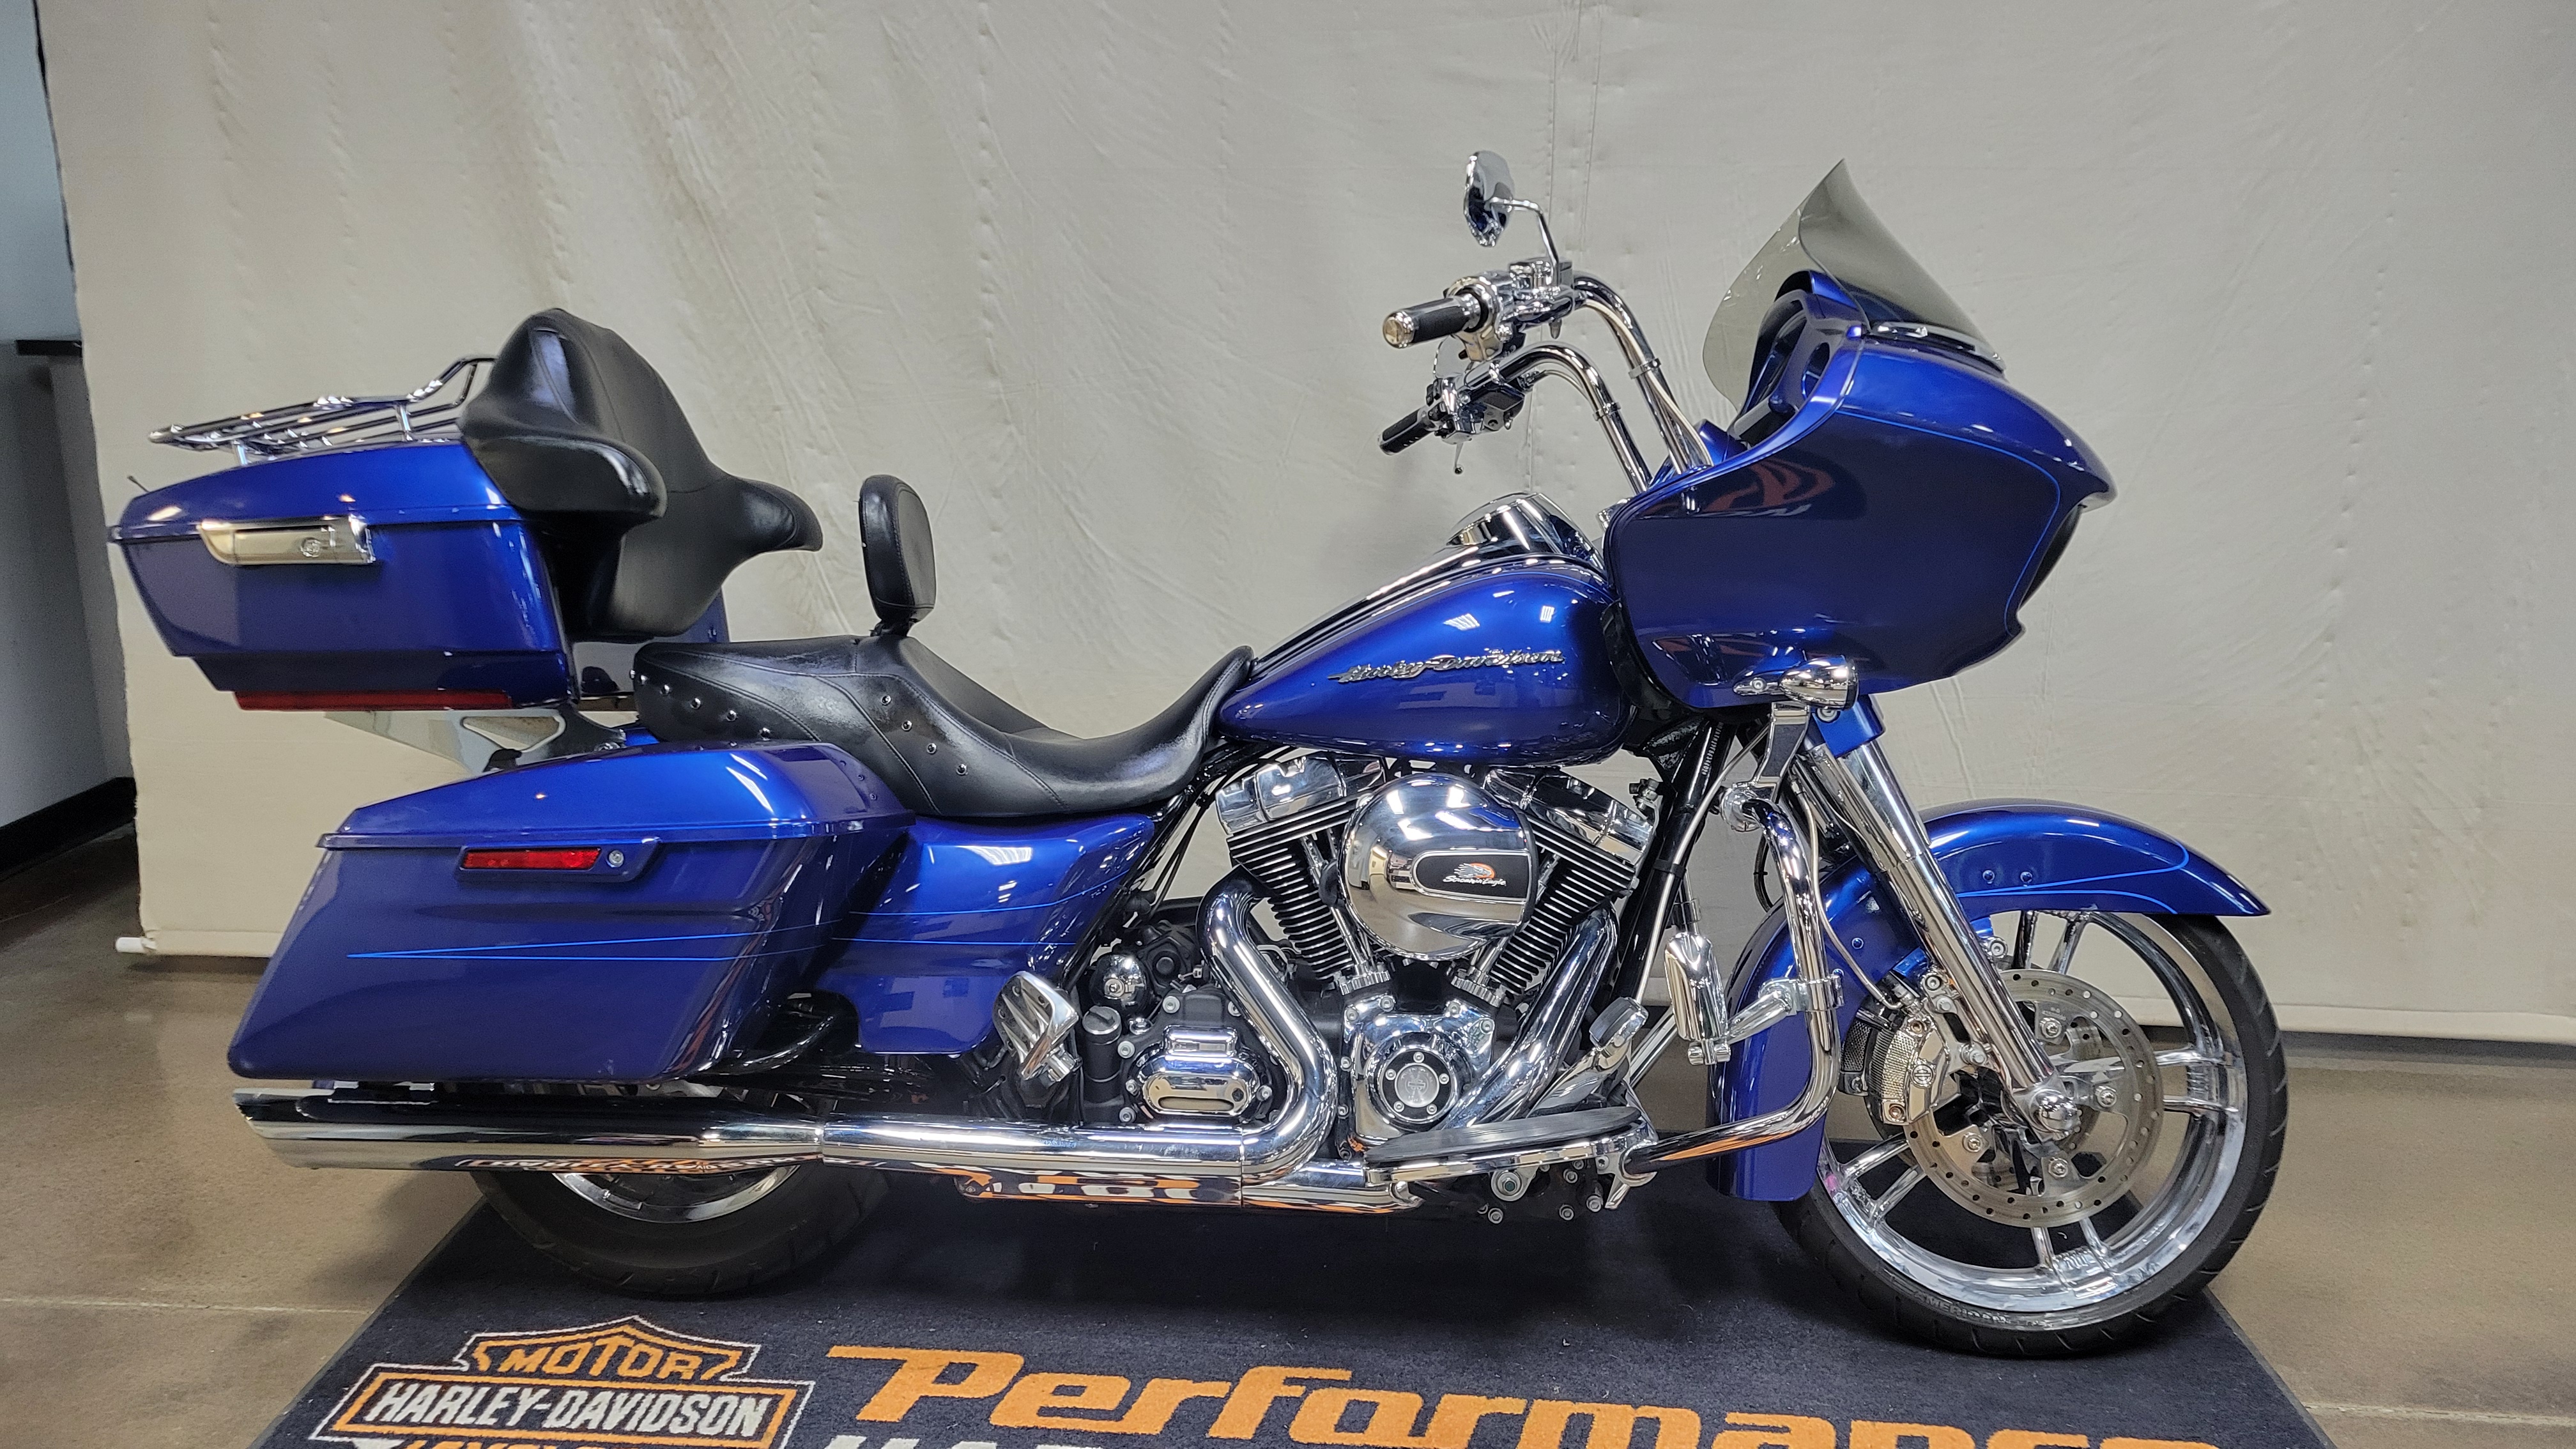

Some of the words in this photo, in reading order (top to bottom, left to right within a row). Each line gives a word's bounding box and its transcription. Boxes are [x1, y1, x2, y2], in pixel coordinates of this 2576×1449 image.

[1482, 877, 1506, 887] Eagle
[499, 1335, 702, 1380] MOTOR
[364, 1381, 772, 1438] HARLEY-DAVIDSON
[827, 1346, 2218, 1449] Performa
